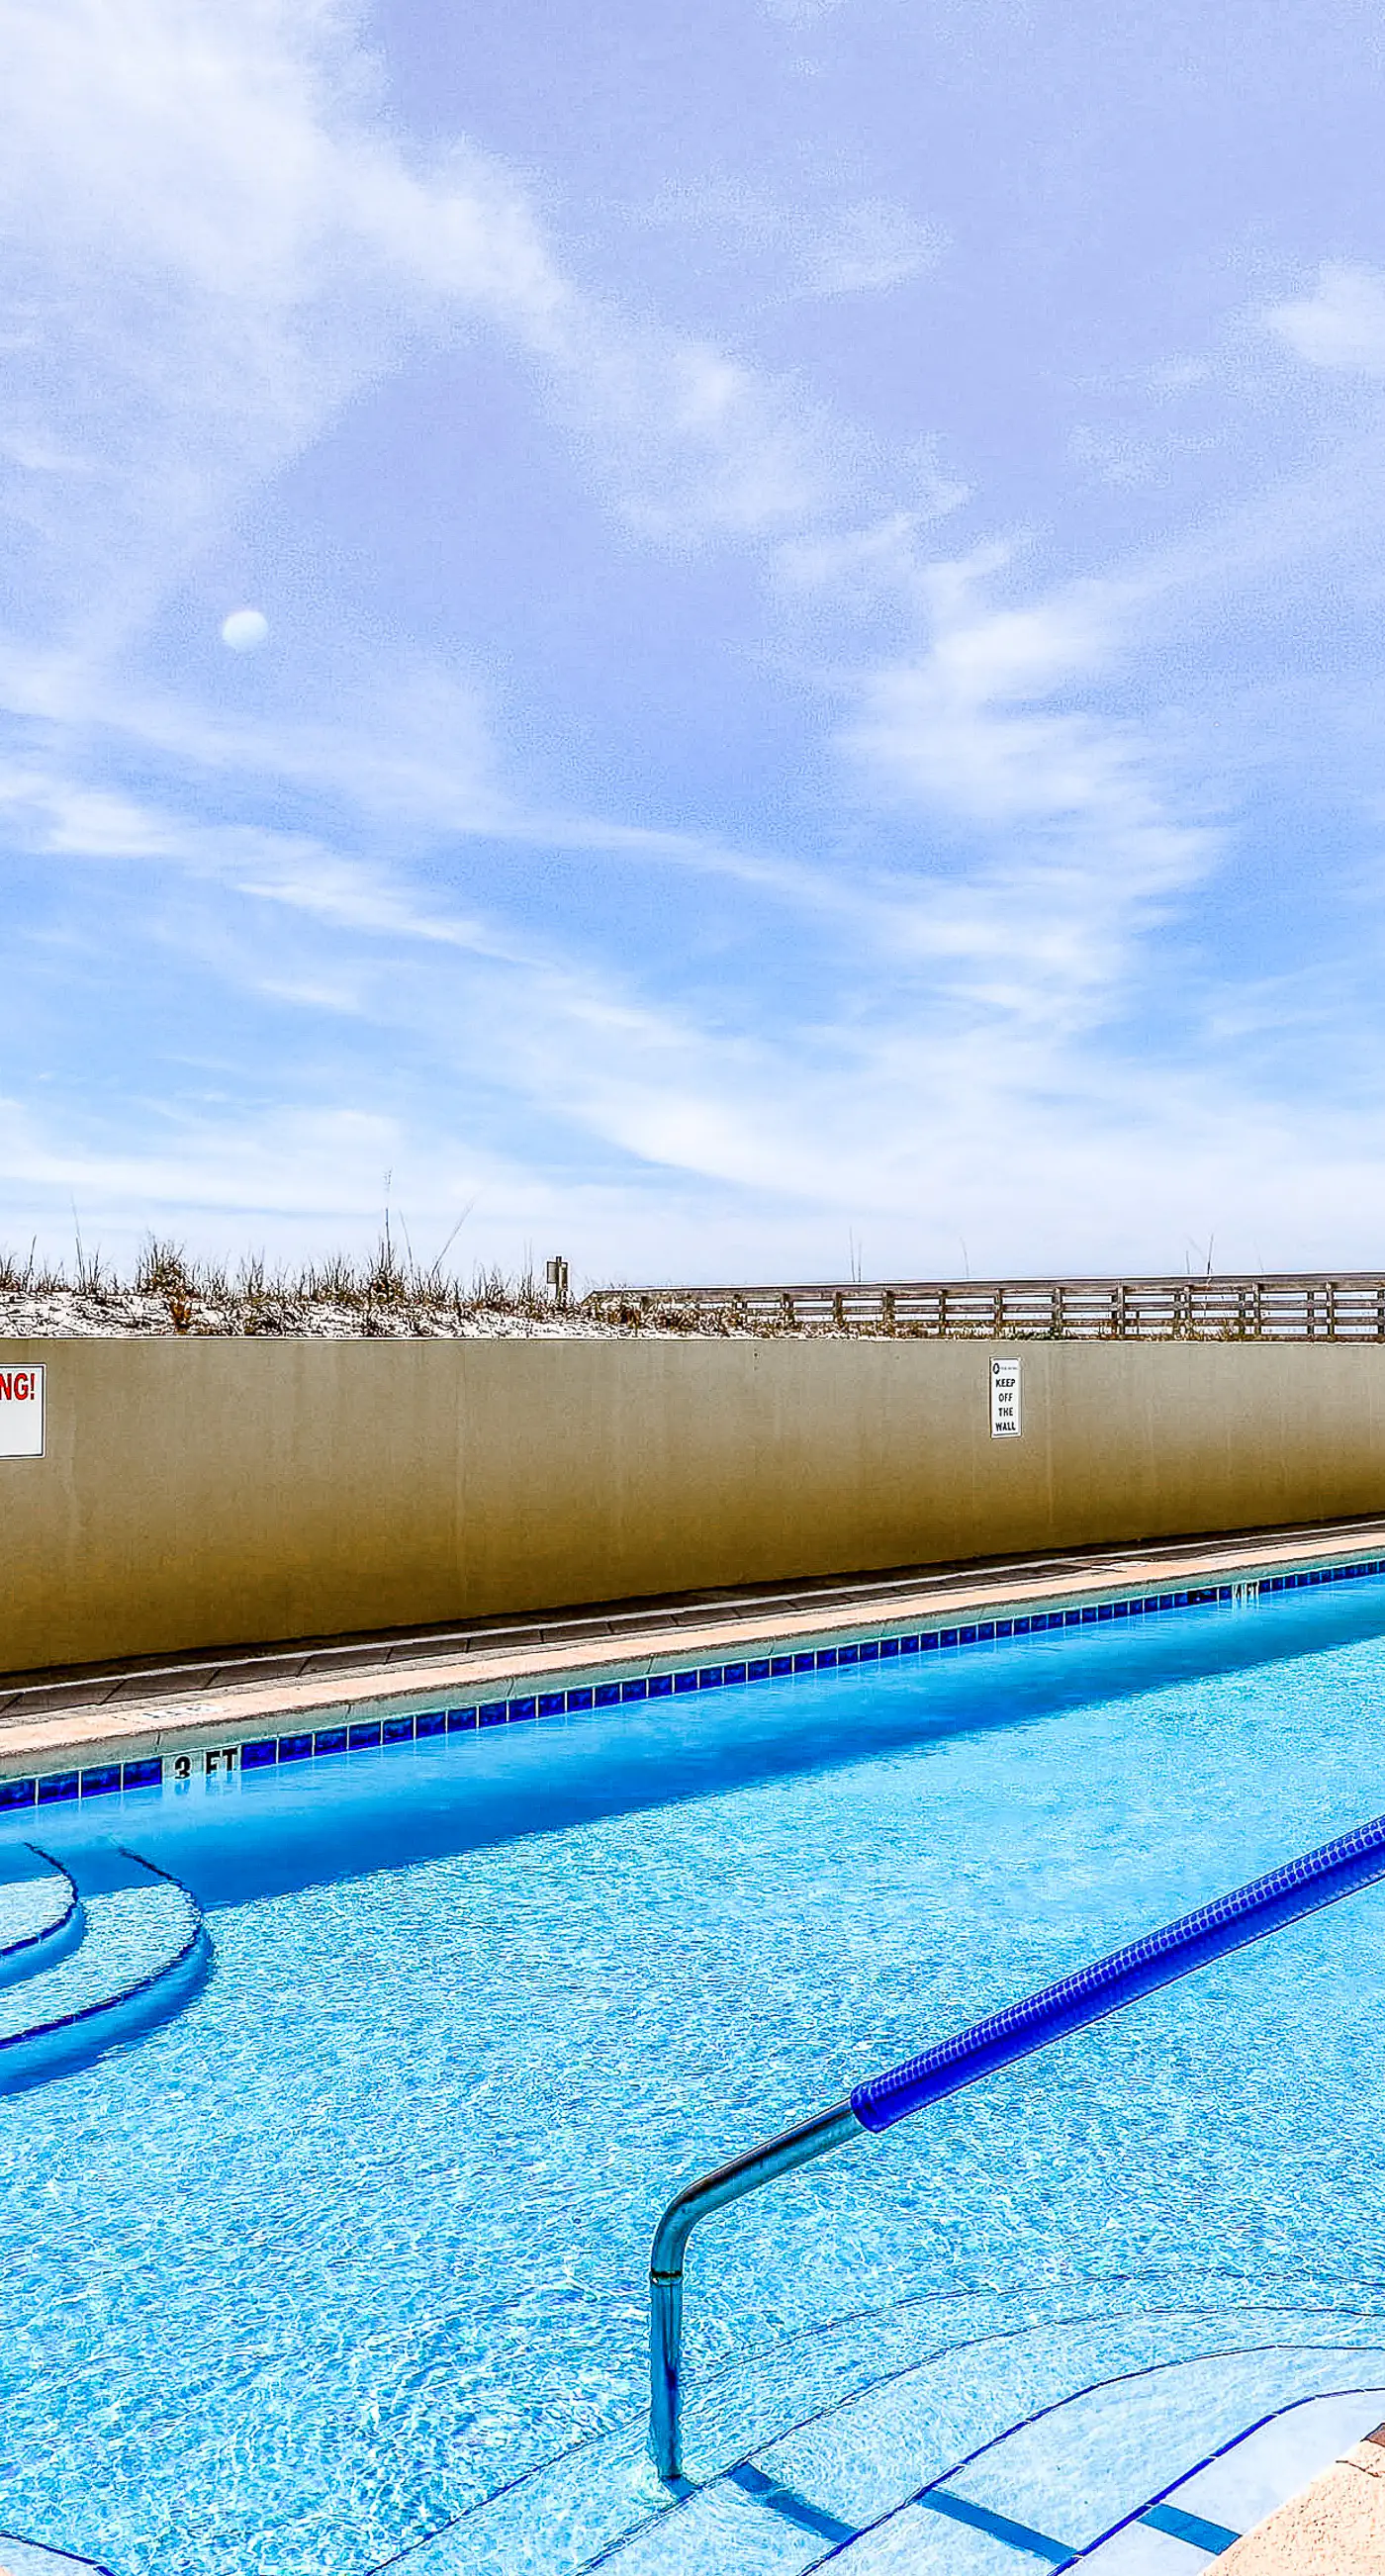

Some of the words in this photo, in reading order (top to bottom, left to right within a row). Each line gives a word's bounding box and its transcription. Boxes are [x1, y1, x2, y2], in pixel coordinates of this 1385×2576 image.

[995, 1378, 1016, 1388] KEEP
[998, 1393, 1013, 1403] OFF
[998, 1407, 1014, 1417] THE
[995, 1422, 1016, 1431] WALL
[174, 1755, 192, 1780] 3
[206, 1747, 237, 1775] FT
